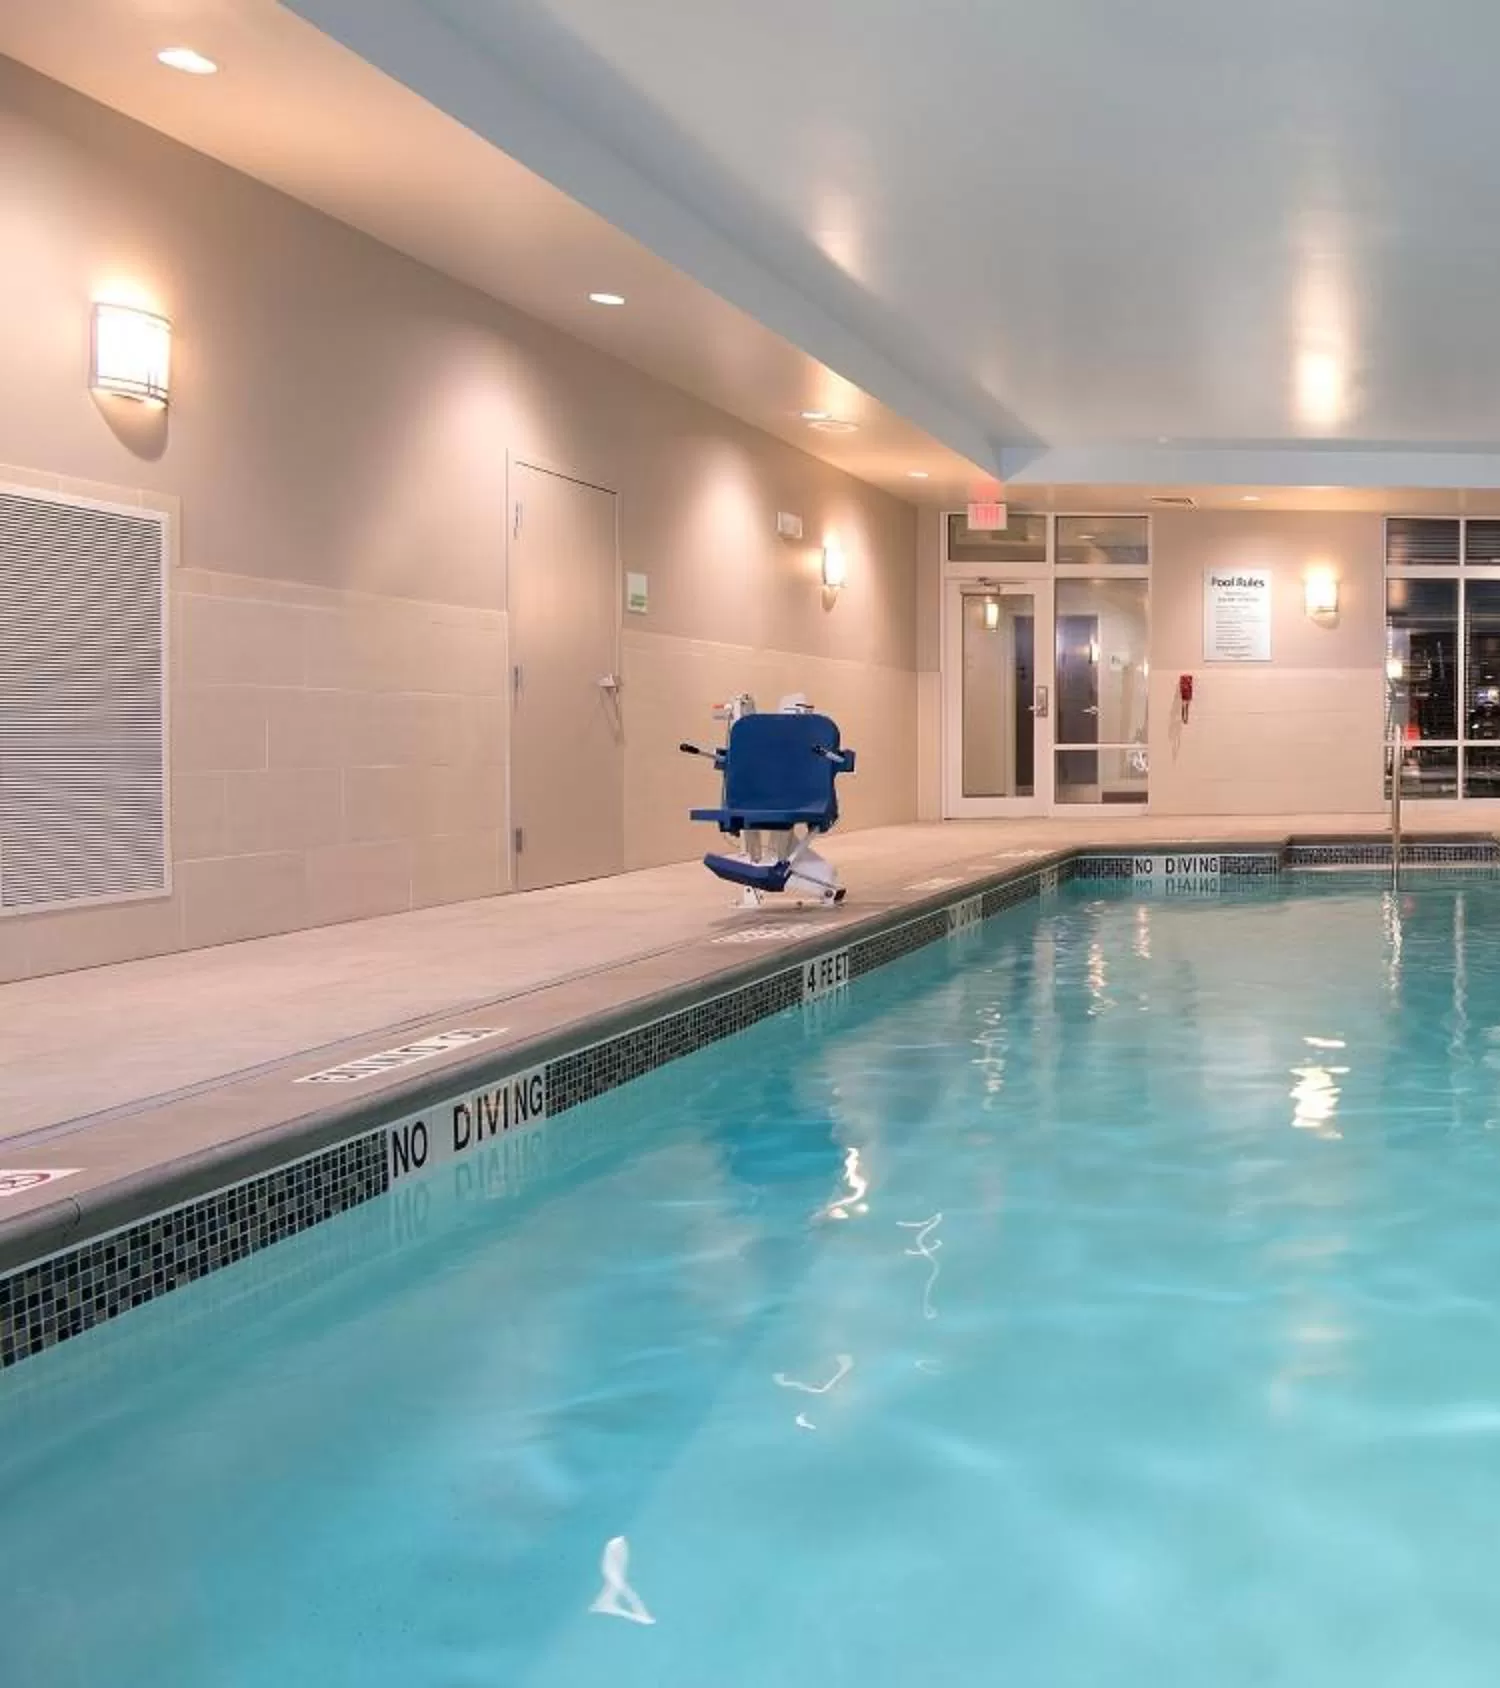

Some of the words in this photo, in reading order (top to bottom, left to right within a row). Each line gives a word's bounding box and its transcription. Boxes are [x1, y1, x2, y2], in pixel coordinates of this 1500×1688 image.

[1211, 576, 1235, 588] Pool
[1135, 858, 1153, 874] NO
[1165, 857, 1218, 874] DIVING
[808, 963, 816, 992] 4
[820, 951, 849, 989] FEET
[392, 1121, 428, 1178] NO
[453, 1074, 543, 1152] DIVING
